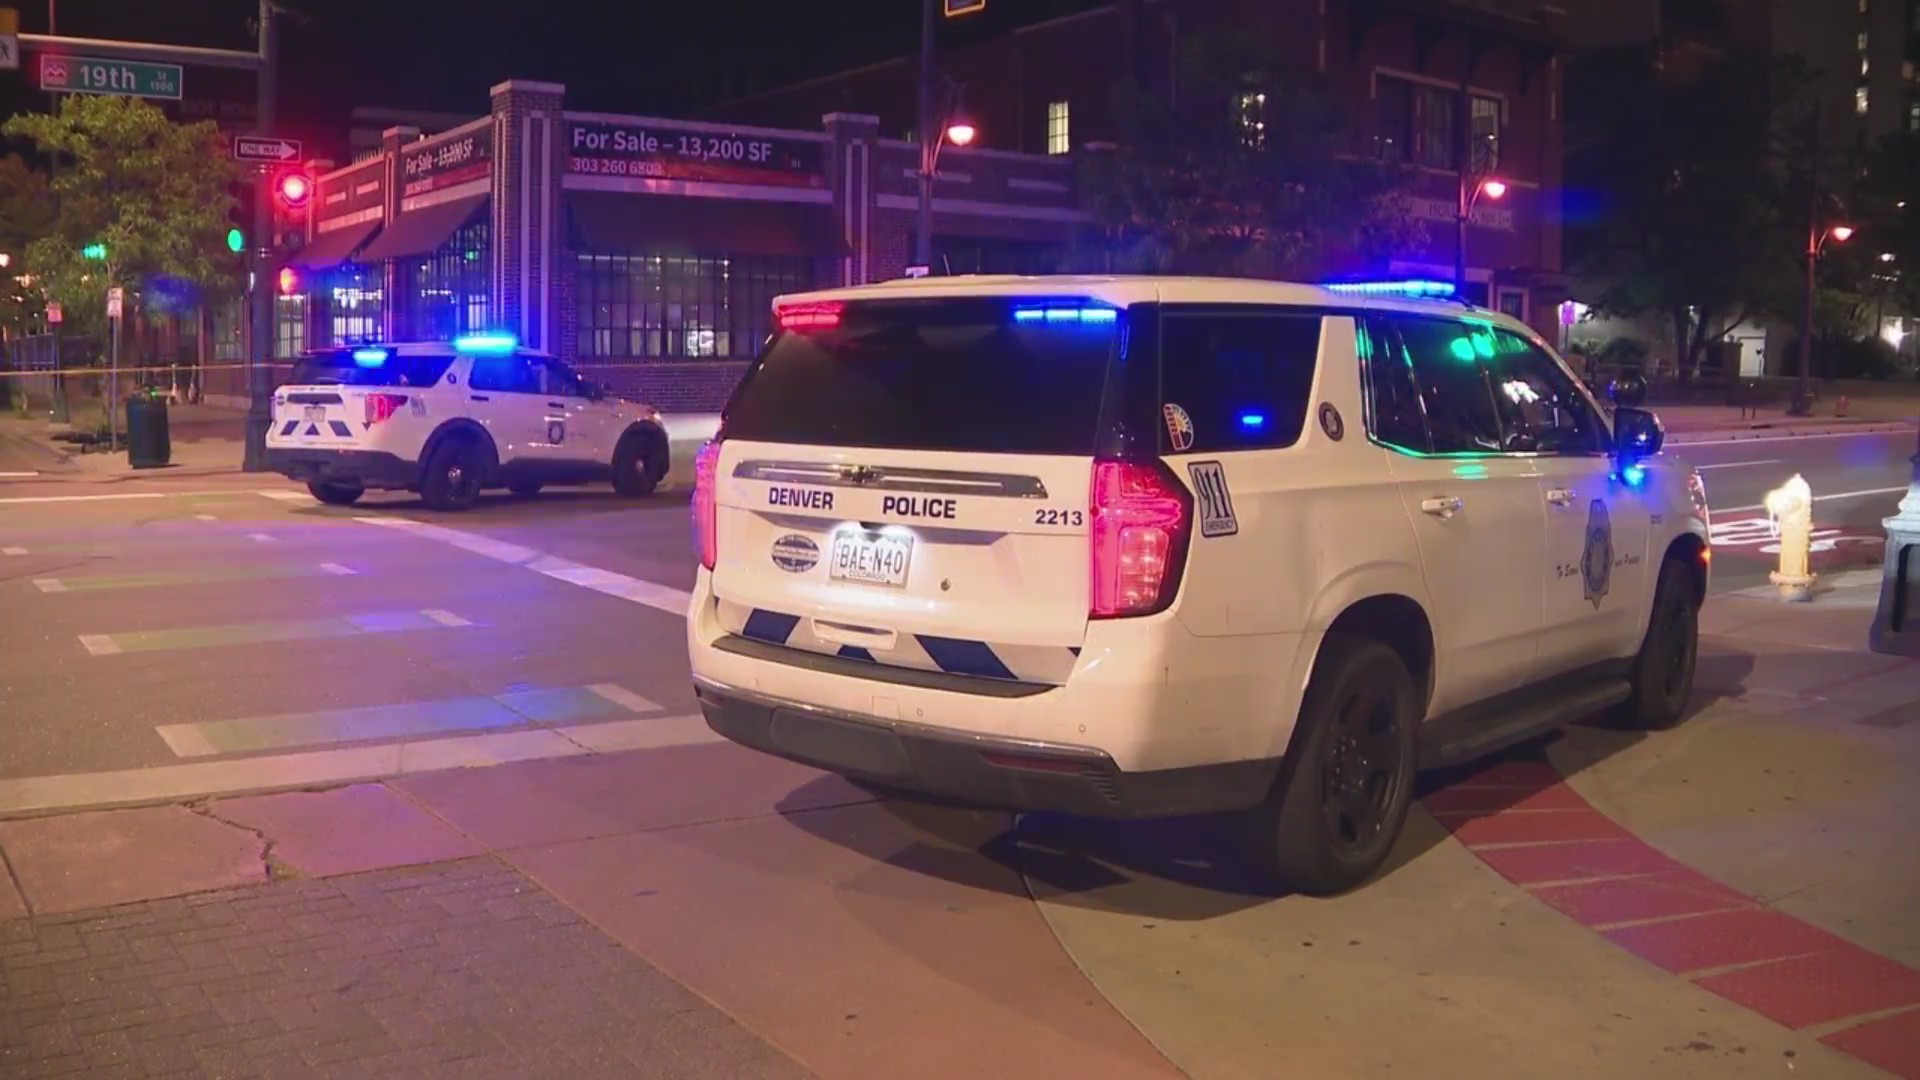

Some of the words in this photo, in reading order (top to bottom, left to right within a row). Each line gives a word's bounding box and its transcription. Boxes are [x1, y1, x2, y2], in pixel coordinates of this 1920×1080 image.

[80, 65, 136, 90] 19th
[262, 144, 280, 155] WAY
[406, 157, 418, 175] For
[418, 152, 433, 170] Sale
[463, 137, 473, 160] SF
[573, 127, 607, 148] For
[614, 130, 658, 153] Sale
[678, 136, 744, 161] 13,200
[748, 142, 773, 162] SF
[572, 158, 598, 173] 303
[601, 159, 627, 174] 260
[768, 487, 834, 510] DENVER
[882, 495, 957, 519] POLICE
[1194, 466, 1230, 520] 911
[1034, 508, 1083, 527] 2213
